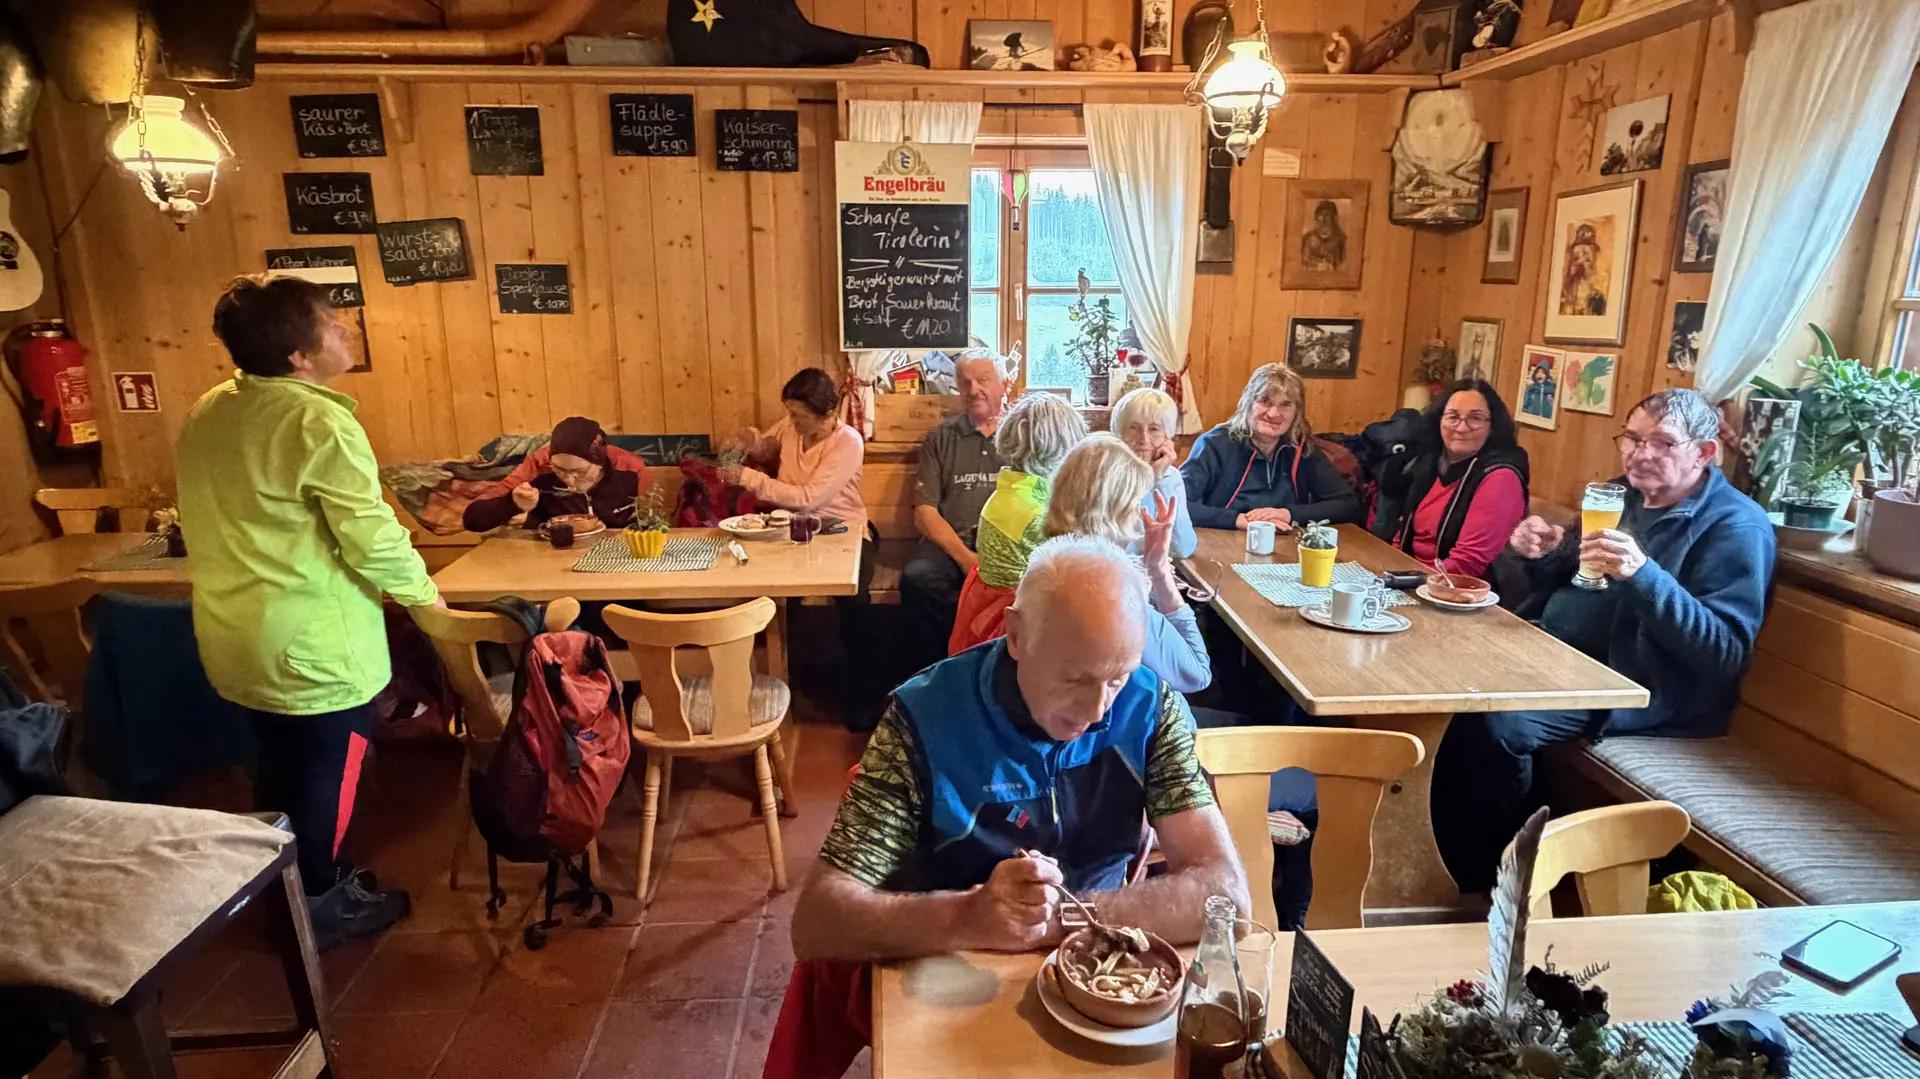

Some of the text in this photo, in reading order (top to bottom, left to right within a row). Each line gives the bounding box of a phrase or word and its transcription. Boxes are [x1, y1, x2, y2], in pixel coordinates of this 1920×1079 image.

[299, 108, 366, 121] saurer
[615, 103, 685, 121] Flädle-
[620, 125, 676, 142] suppe
[723, 117, 786, 134] Kaiser-
[863, 176, 946, 195] Engelbräu
[296, 184, 364, 206] Käsbrot
[845, 206, 911, 232] Scharfe
[943, 270, 964, 284] mit
[885, 291, 961, 312] Sauerkraut
